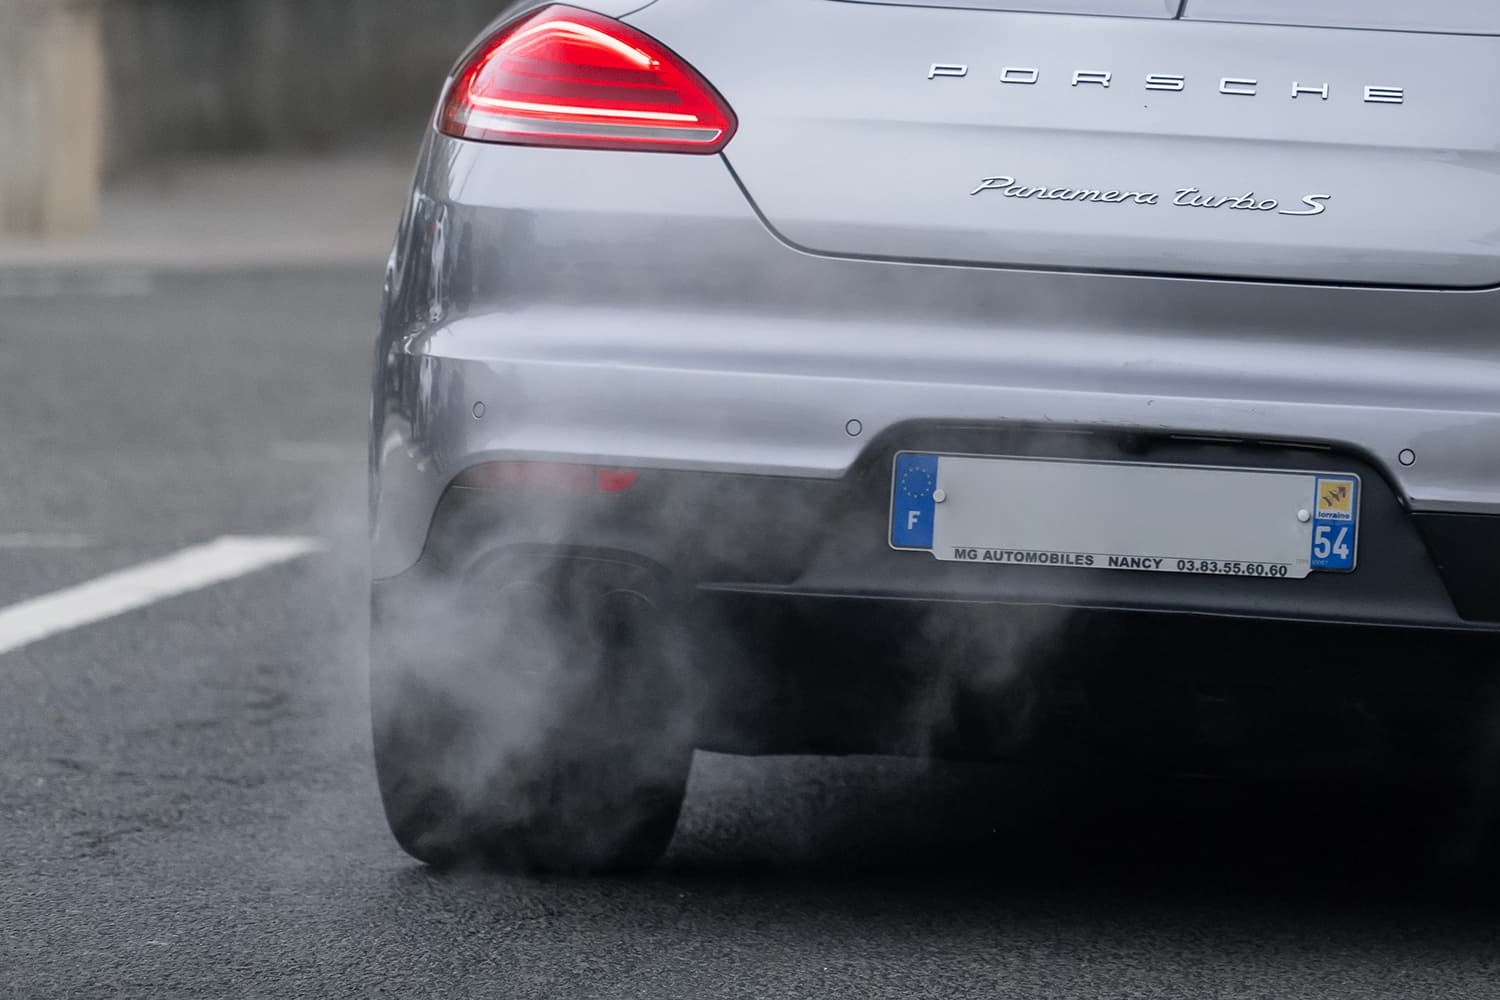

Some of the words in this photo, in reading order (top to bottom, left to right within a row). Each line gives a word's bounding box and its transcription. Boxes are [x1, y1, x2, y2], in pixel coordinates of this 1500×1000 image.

[927, 63, 1404, 104] PORSCHE
[970, 175, 1158, 206] Panamera
[1279, 193, 1331, 216] S
[907, 510, 921, 530] F
[1313, 525, 1350, 560] 54
[954, 548, 978, 561] MG
[982, 550, 1095, 566] AUTOMOBILES
[1108, 556, 1163, 570] NANCY
[1176, 559, 1288, 577] 03.83.55.60.60
